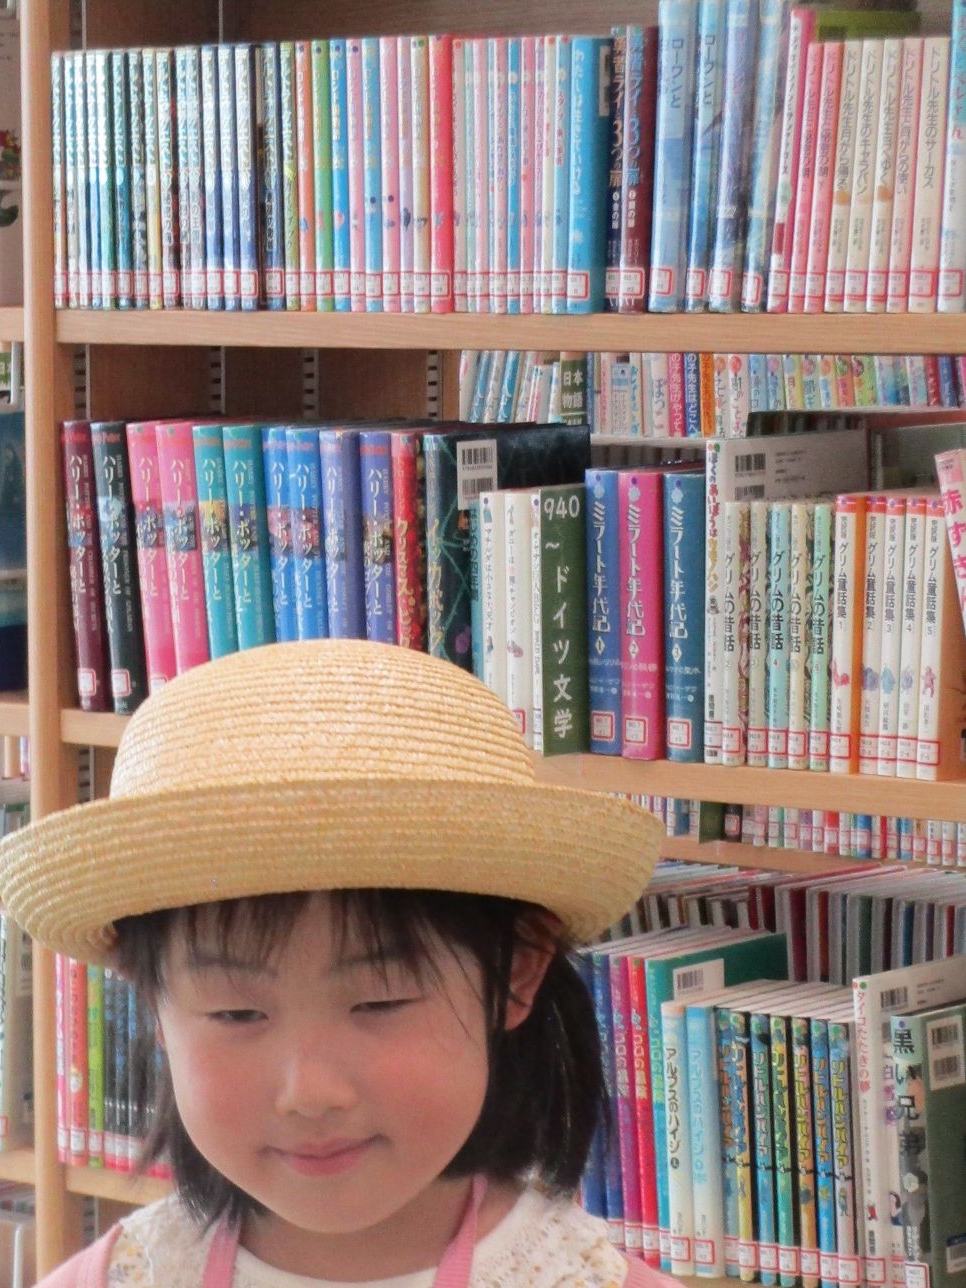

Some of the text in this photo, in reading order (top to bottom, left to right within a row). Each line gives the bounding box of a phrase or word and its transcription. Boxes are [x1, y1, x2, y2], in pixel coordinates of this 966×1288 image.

[671, 38, 684, 110] ローワンと
[856, 49, 876, 197] ドリトル先生のキャラバン
[923, 47, 941, 189] ドリトル先生のサーカス
[69, 456, 87, 594] ハリー・ポッターと
[103, 455, 122, 595] ハリー・ポッターと
[138, 456, 158, 597] ハリー・ポッターと
[170, 459, 190, 600] ハリー・ポッターと
[203, 459, 222, 600] ハリー・ポッターと
[234, 460, 252, 604] ハリー・ポッターと
[272, 461, 289, 606] ハリー・ポッターと
[295, 463, 312, 608] ハリー・ポッターと
[326, 466, 339, 613] ハリー・ポッターと
[367, 468, 384, 616] ハリー・ポッターと
[543, 495, 580, 521] 940
[592, 501, 611, 634] ミラート年代記
[626, 504, 646, 637] ミラート年代記
[669, 506, 689, 640] ミラート年代記
[707, 452, 721, 593] ぼくのあいぼうはカモノハシ
[724, 553, 736, 652] グリムの昔話
[750, 553, 762, 651] グリムの昔話
[771, 551, 784, 651] グリムの昔話
[790, 553, 803, 653] グリムの昔話
[812, 554, 826, 655] グリムの昔話
[837, 543, 850, 620] グリム童話集
[866, 543, 877, 620] グリム童話集
[884, 546, 896, 622] グリム童話集
[904, 545, 919, 622] グリム童話集
[924, 548, 938, 625] グリム童話集
[553, 565, 573, 739] ドイツ文学
[666, 1047, 681, 1154] アルプスのハイジ
[893, 1029, 920, 1158] 黒い兄弟
